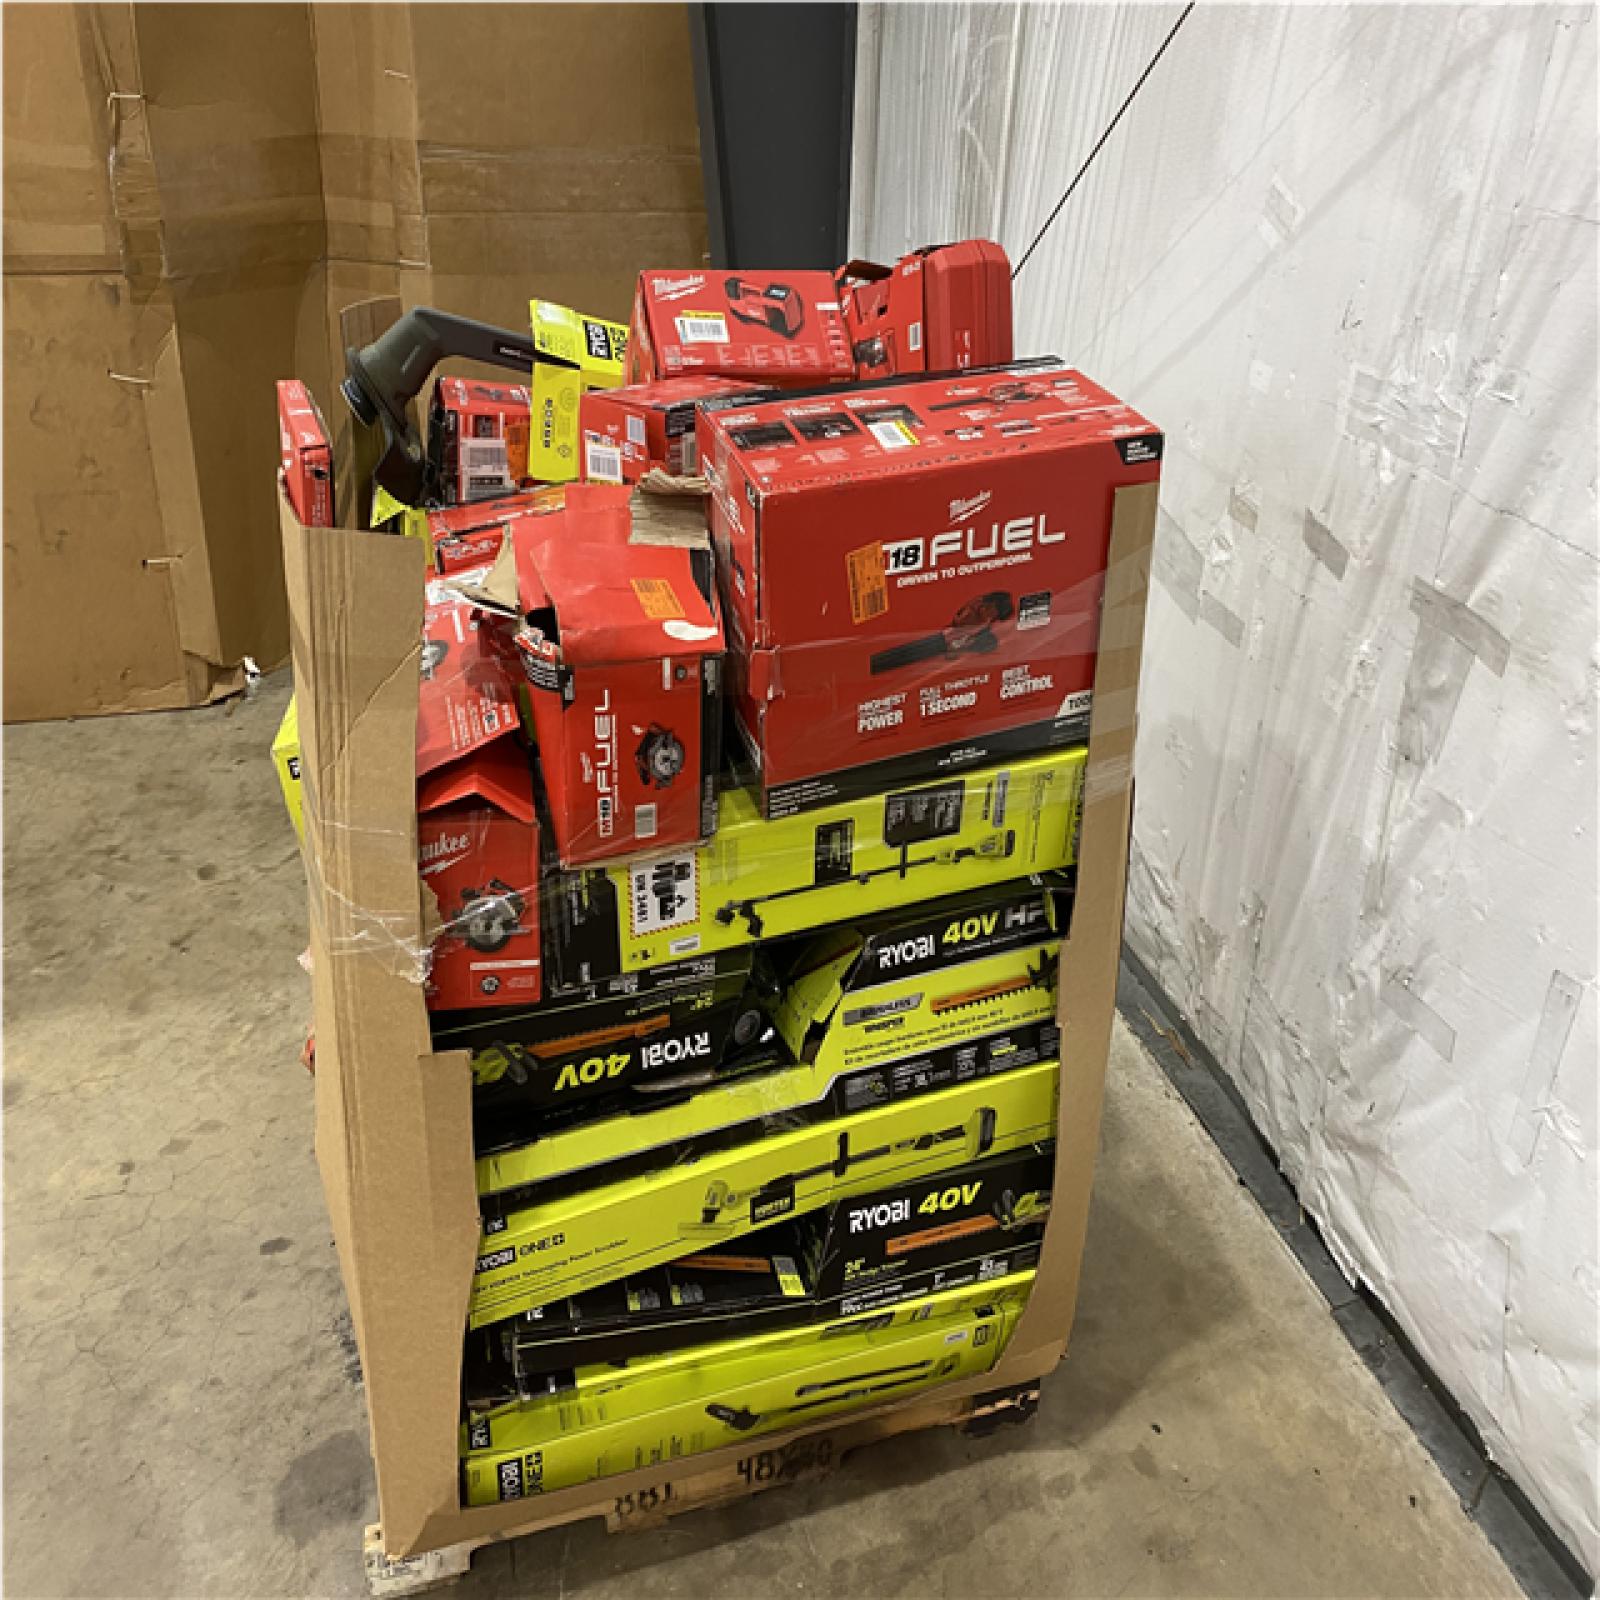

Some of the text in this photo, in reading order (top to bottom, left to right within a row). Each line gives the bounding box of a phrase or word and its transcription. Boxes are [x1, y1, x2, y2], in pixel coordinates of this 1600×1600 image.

[930, 513, 1065, 567] FUEL
[896, 552, 1033, 588] DRIVEN TO OUTPERFORM
[927, 691, 977, 716] SECOND
[1000, 674, 1054, 699] CONTROL
[594, 688, 611, 793] FUEL
[857, 709, 904, 732] POWER
[878, 934, 936, 970] RYOBI
[942, 912, 998, 944] 40V
[553, 1032, 711, 1091] RYOBI 40V
[849, 1181, 983, 1234] RYOBI 40V
